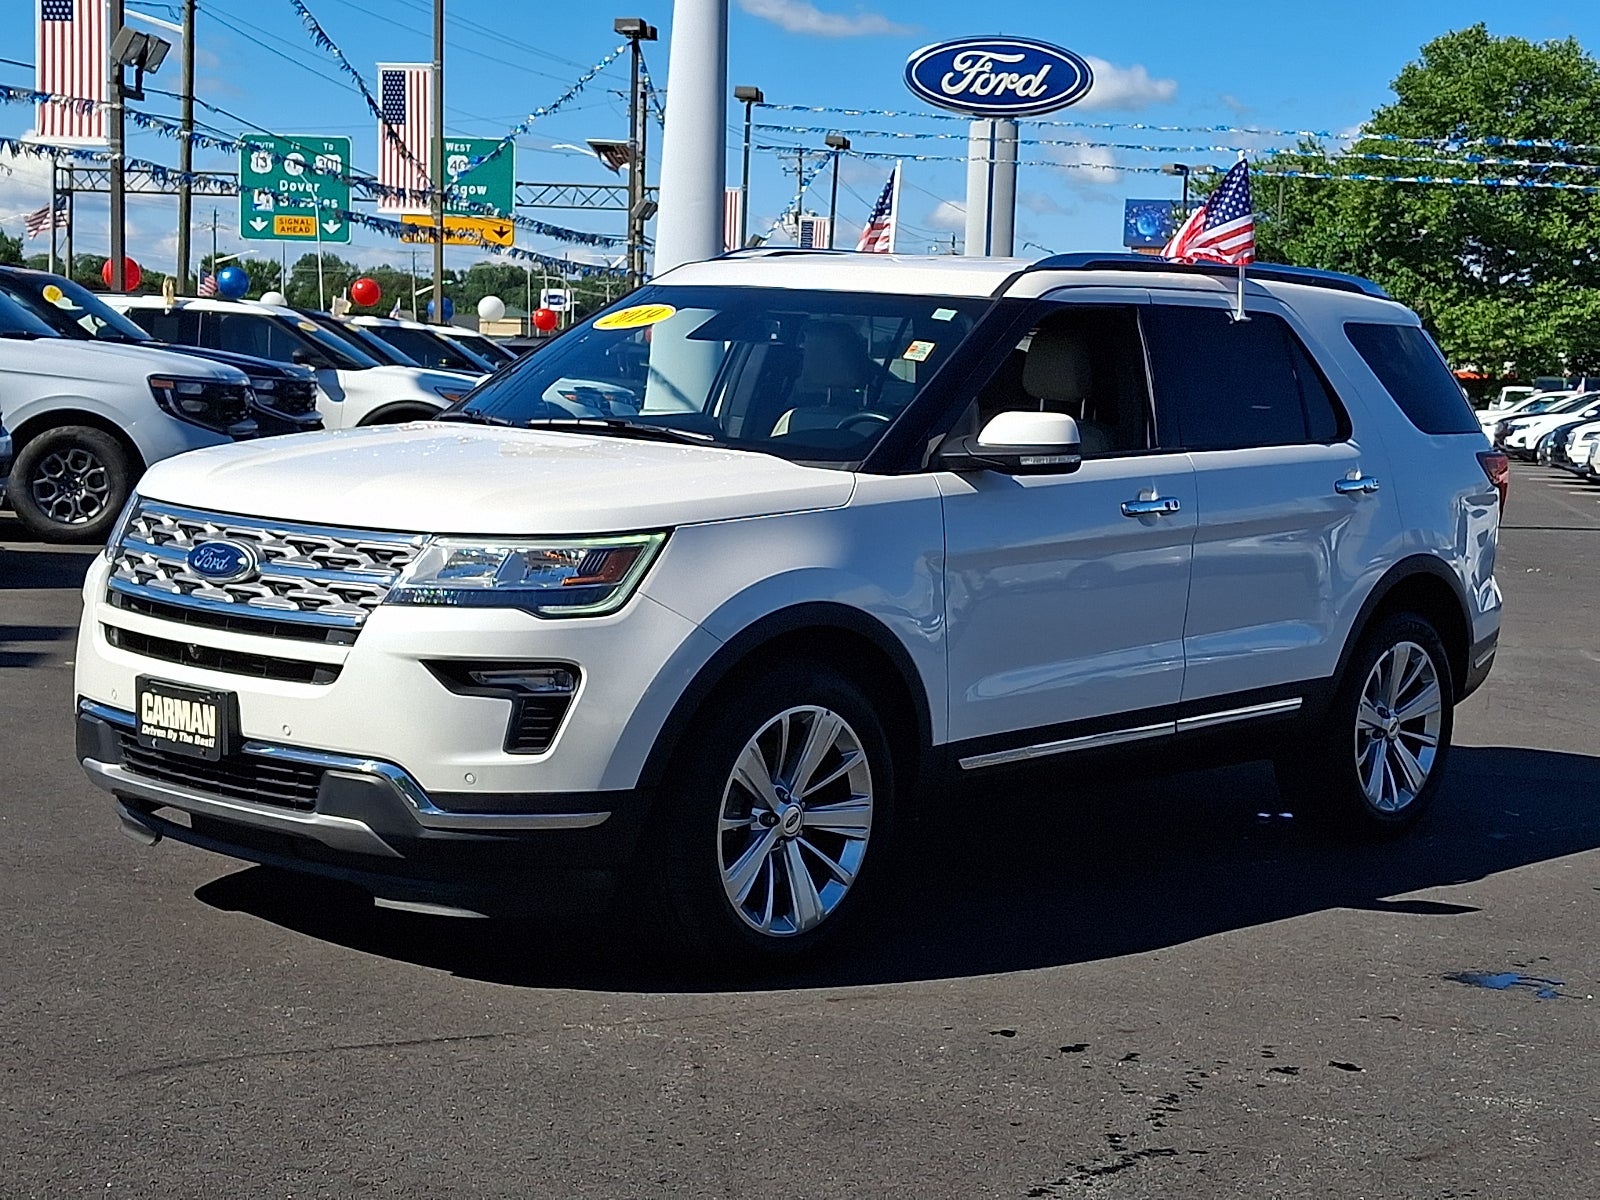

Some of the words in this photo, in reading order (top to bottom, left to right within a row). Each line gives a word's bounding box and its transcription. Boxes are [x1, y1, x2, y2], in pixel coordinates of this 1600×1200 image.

[941, 50, 1052, 97] Ford
[323, 142, 334, 151] TO
[445, 142, 471, 152] WEST
[279, 180, 320, 192] Dover
[279, 217, 311, 226] SIGNAL
[280, 225, 311, 234] AHEAD
[194, 547, 230, 570] Ford
[141, 691, 216, 737] CARMAN
[141, 724, 166, 738] Driven
[167, 729, 178, 742] By
[179, 732, 194, 744] The
